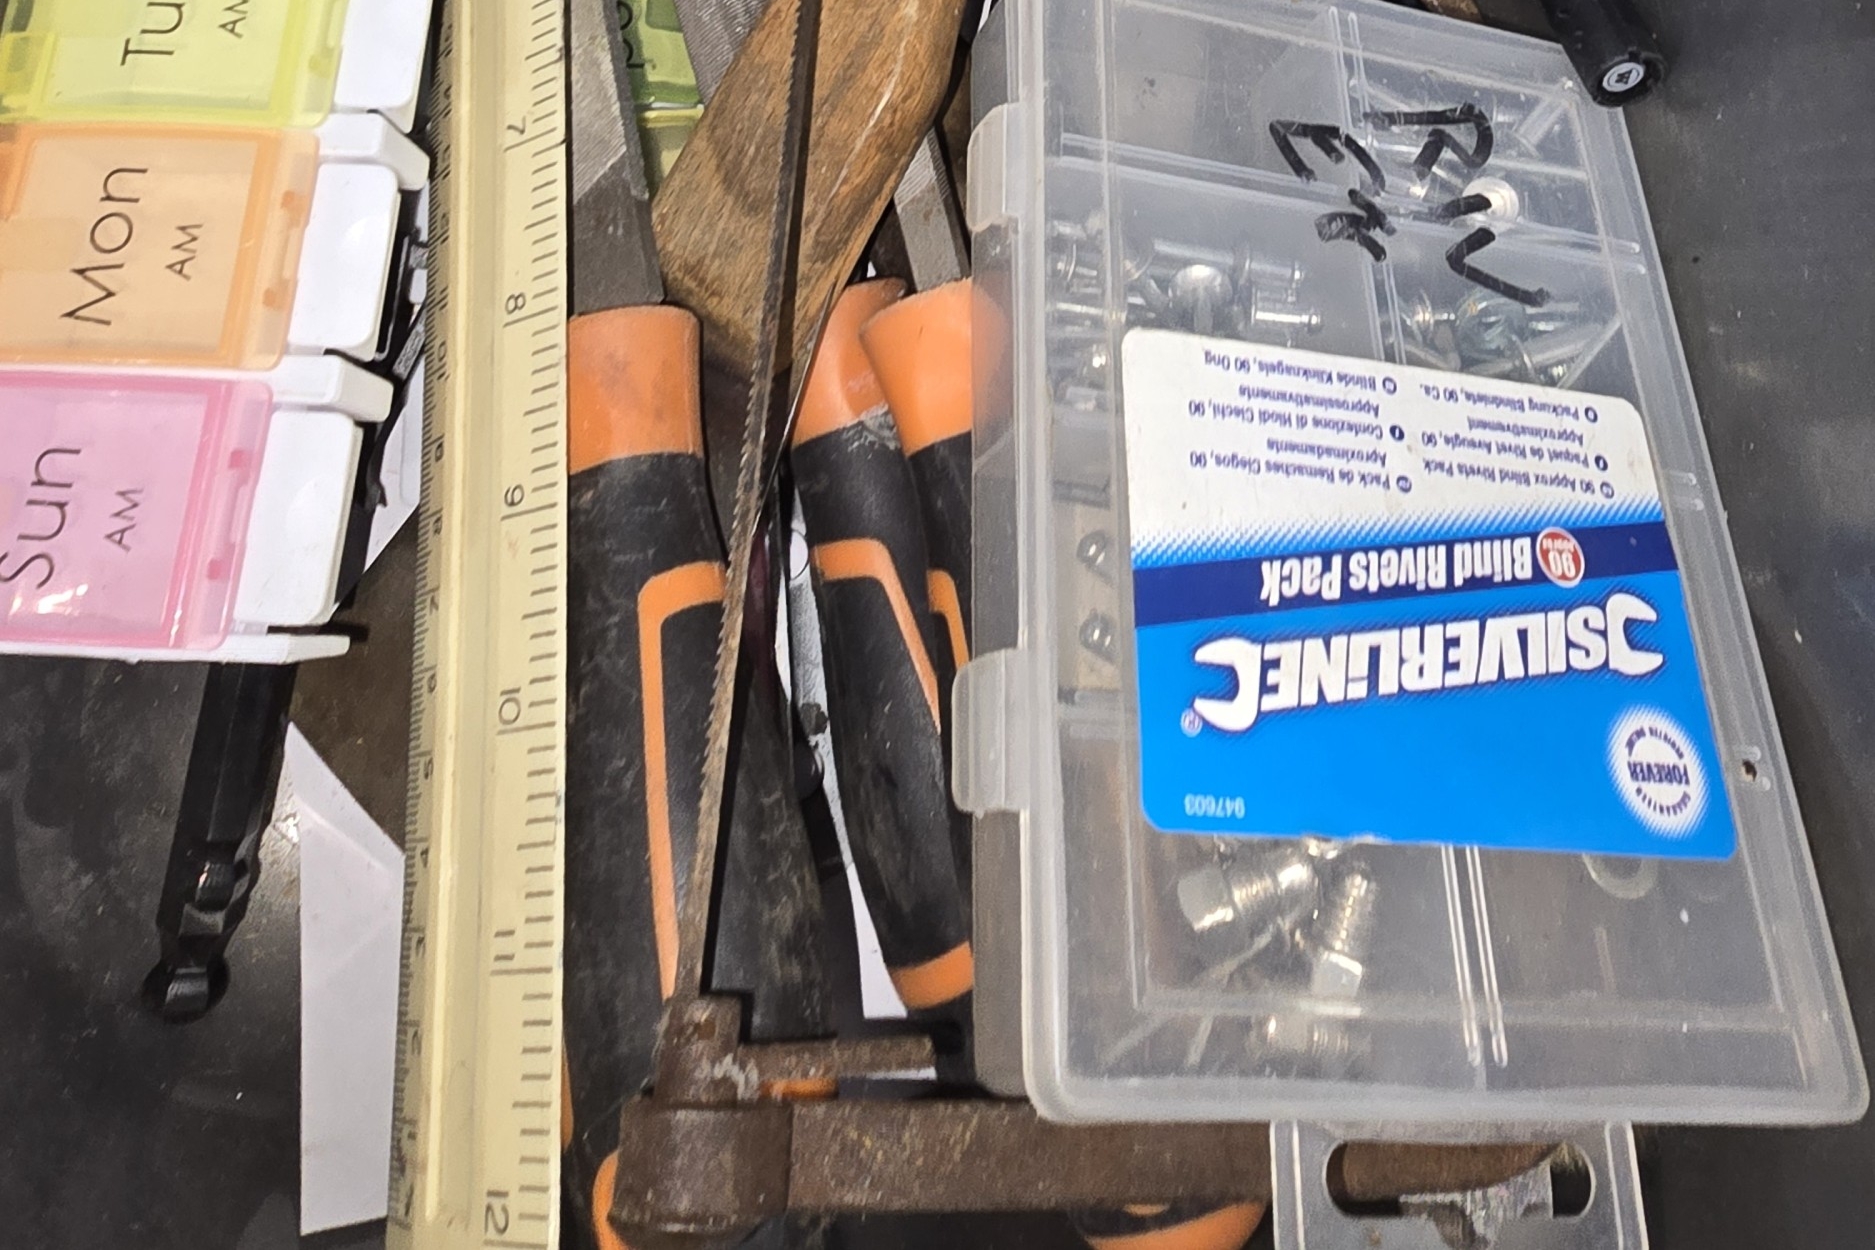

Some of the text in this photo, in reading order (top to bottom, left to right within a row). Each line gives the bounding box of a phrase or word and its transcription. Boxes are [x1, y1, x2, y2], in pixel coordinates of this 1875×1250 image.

[507, 115, 526, 136] 7
[59, 168, 148, 326] Mon
[165, 224, 203, 281] AM
[505, 292, 527, 315] 8
[1234, 357, 1250, 374] 90
[1337, 372, 1376, 391] Blinde
[1420, 384, 1440, 402] Ca.
[1188, 400, 1205, 417] 90
[1529, 397, 1579, 421] Packung
[1296, 414, 1307, 429] di
[1312, 416, 1383, 440] Confezione
[1190, 451, 1207, 468] 90
[1496, 441, 1526, 459] Rivet
[1530, 446, 1544, 461] de
[1548, 448, 1589, 469] Paquet
[1209, 451, 1261, 475] Ciegos,
[1265, 460, 1335, 484] Remaches
[1423, 459, 1453, 478] Pack
[1457, 463, 1495, 483] Rivets
[1338, 469, 1354, 484] de
[1358, 473, 1390, 491] Pack
[1499, 469, 1531, 487] Blind
[504, 484, 525, 508] 9
[0, 447, 82, 589] Sun
[103, 488, 144, 553] AM
[1260, 537, 1532, 607] Blind Rivets Pack
[1548, 550, 1575, 579] 90
[427, 673, 437, 694] 6
[499, 687, 521, 725] 10
[423, 757, 434, 780] 5
[1627, 761, 1690, 786] FOREVER
[420, 847, 430, 868] 4
[494, 929, 516, 962] 11
[484, 1189, 510, 1236] 12
